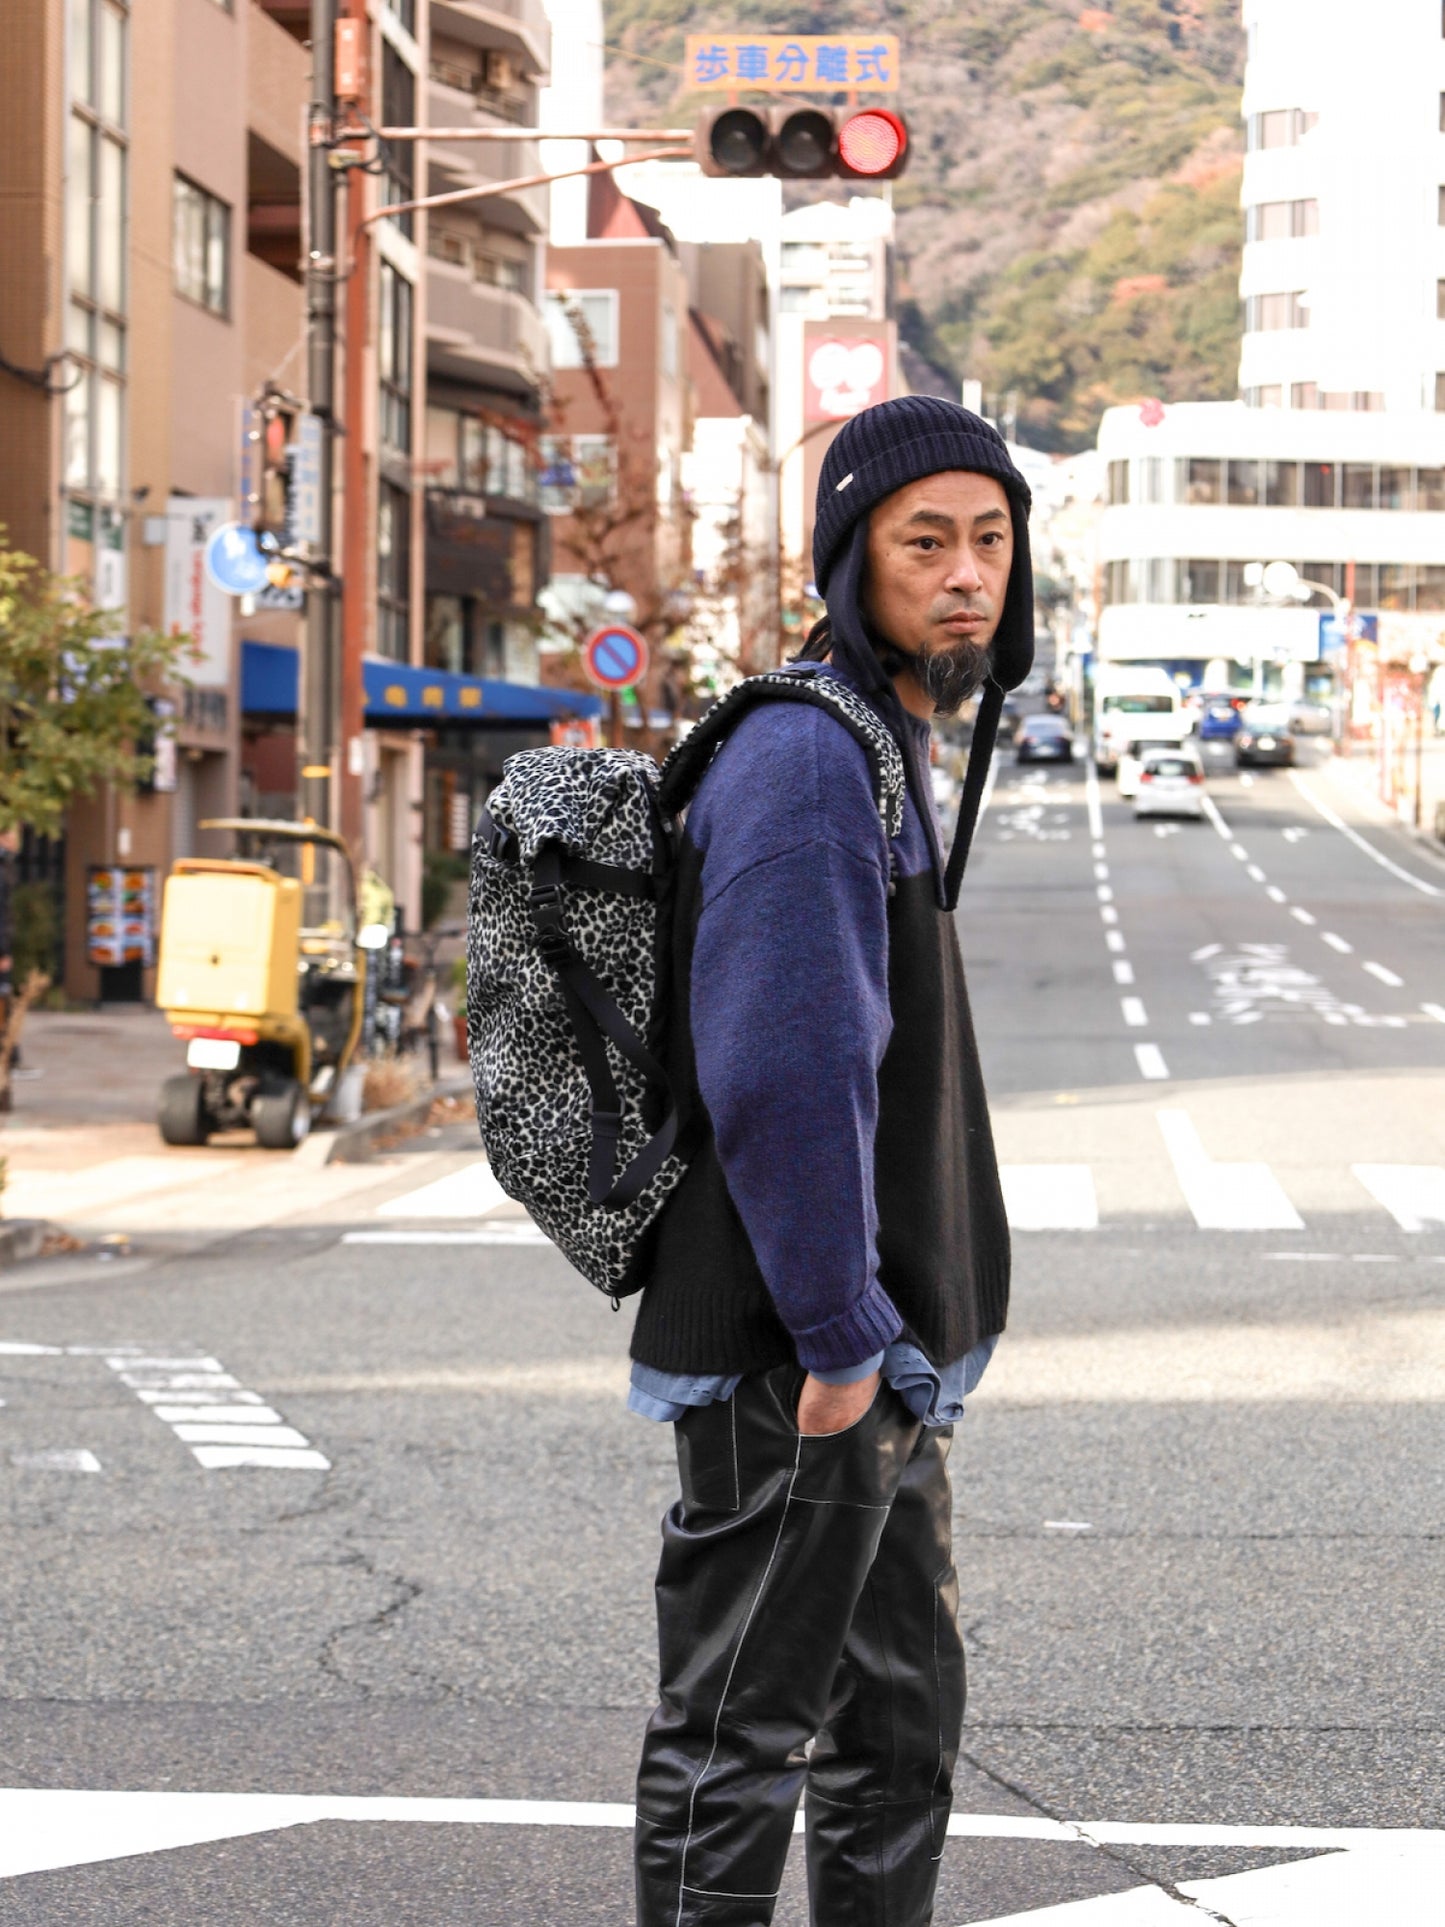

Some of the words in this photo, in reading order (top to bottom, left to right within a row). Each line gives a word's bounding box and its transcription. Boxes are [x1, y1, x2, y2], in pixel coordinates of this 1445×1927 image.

[695, 44, 889, 82] 歩車分離式
